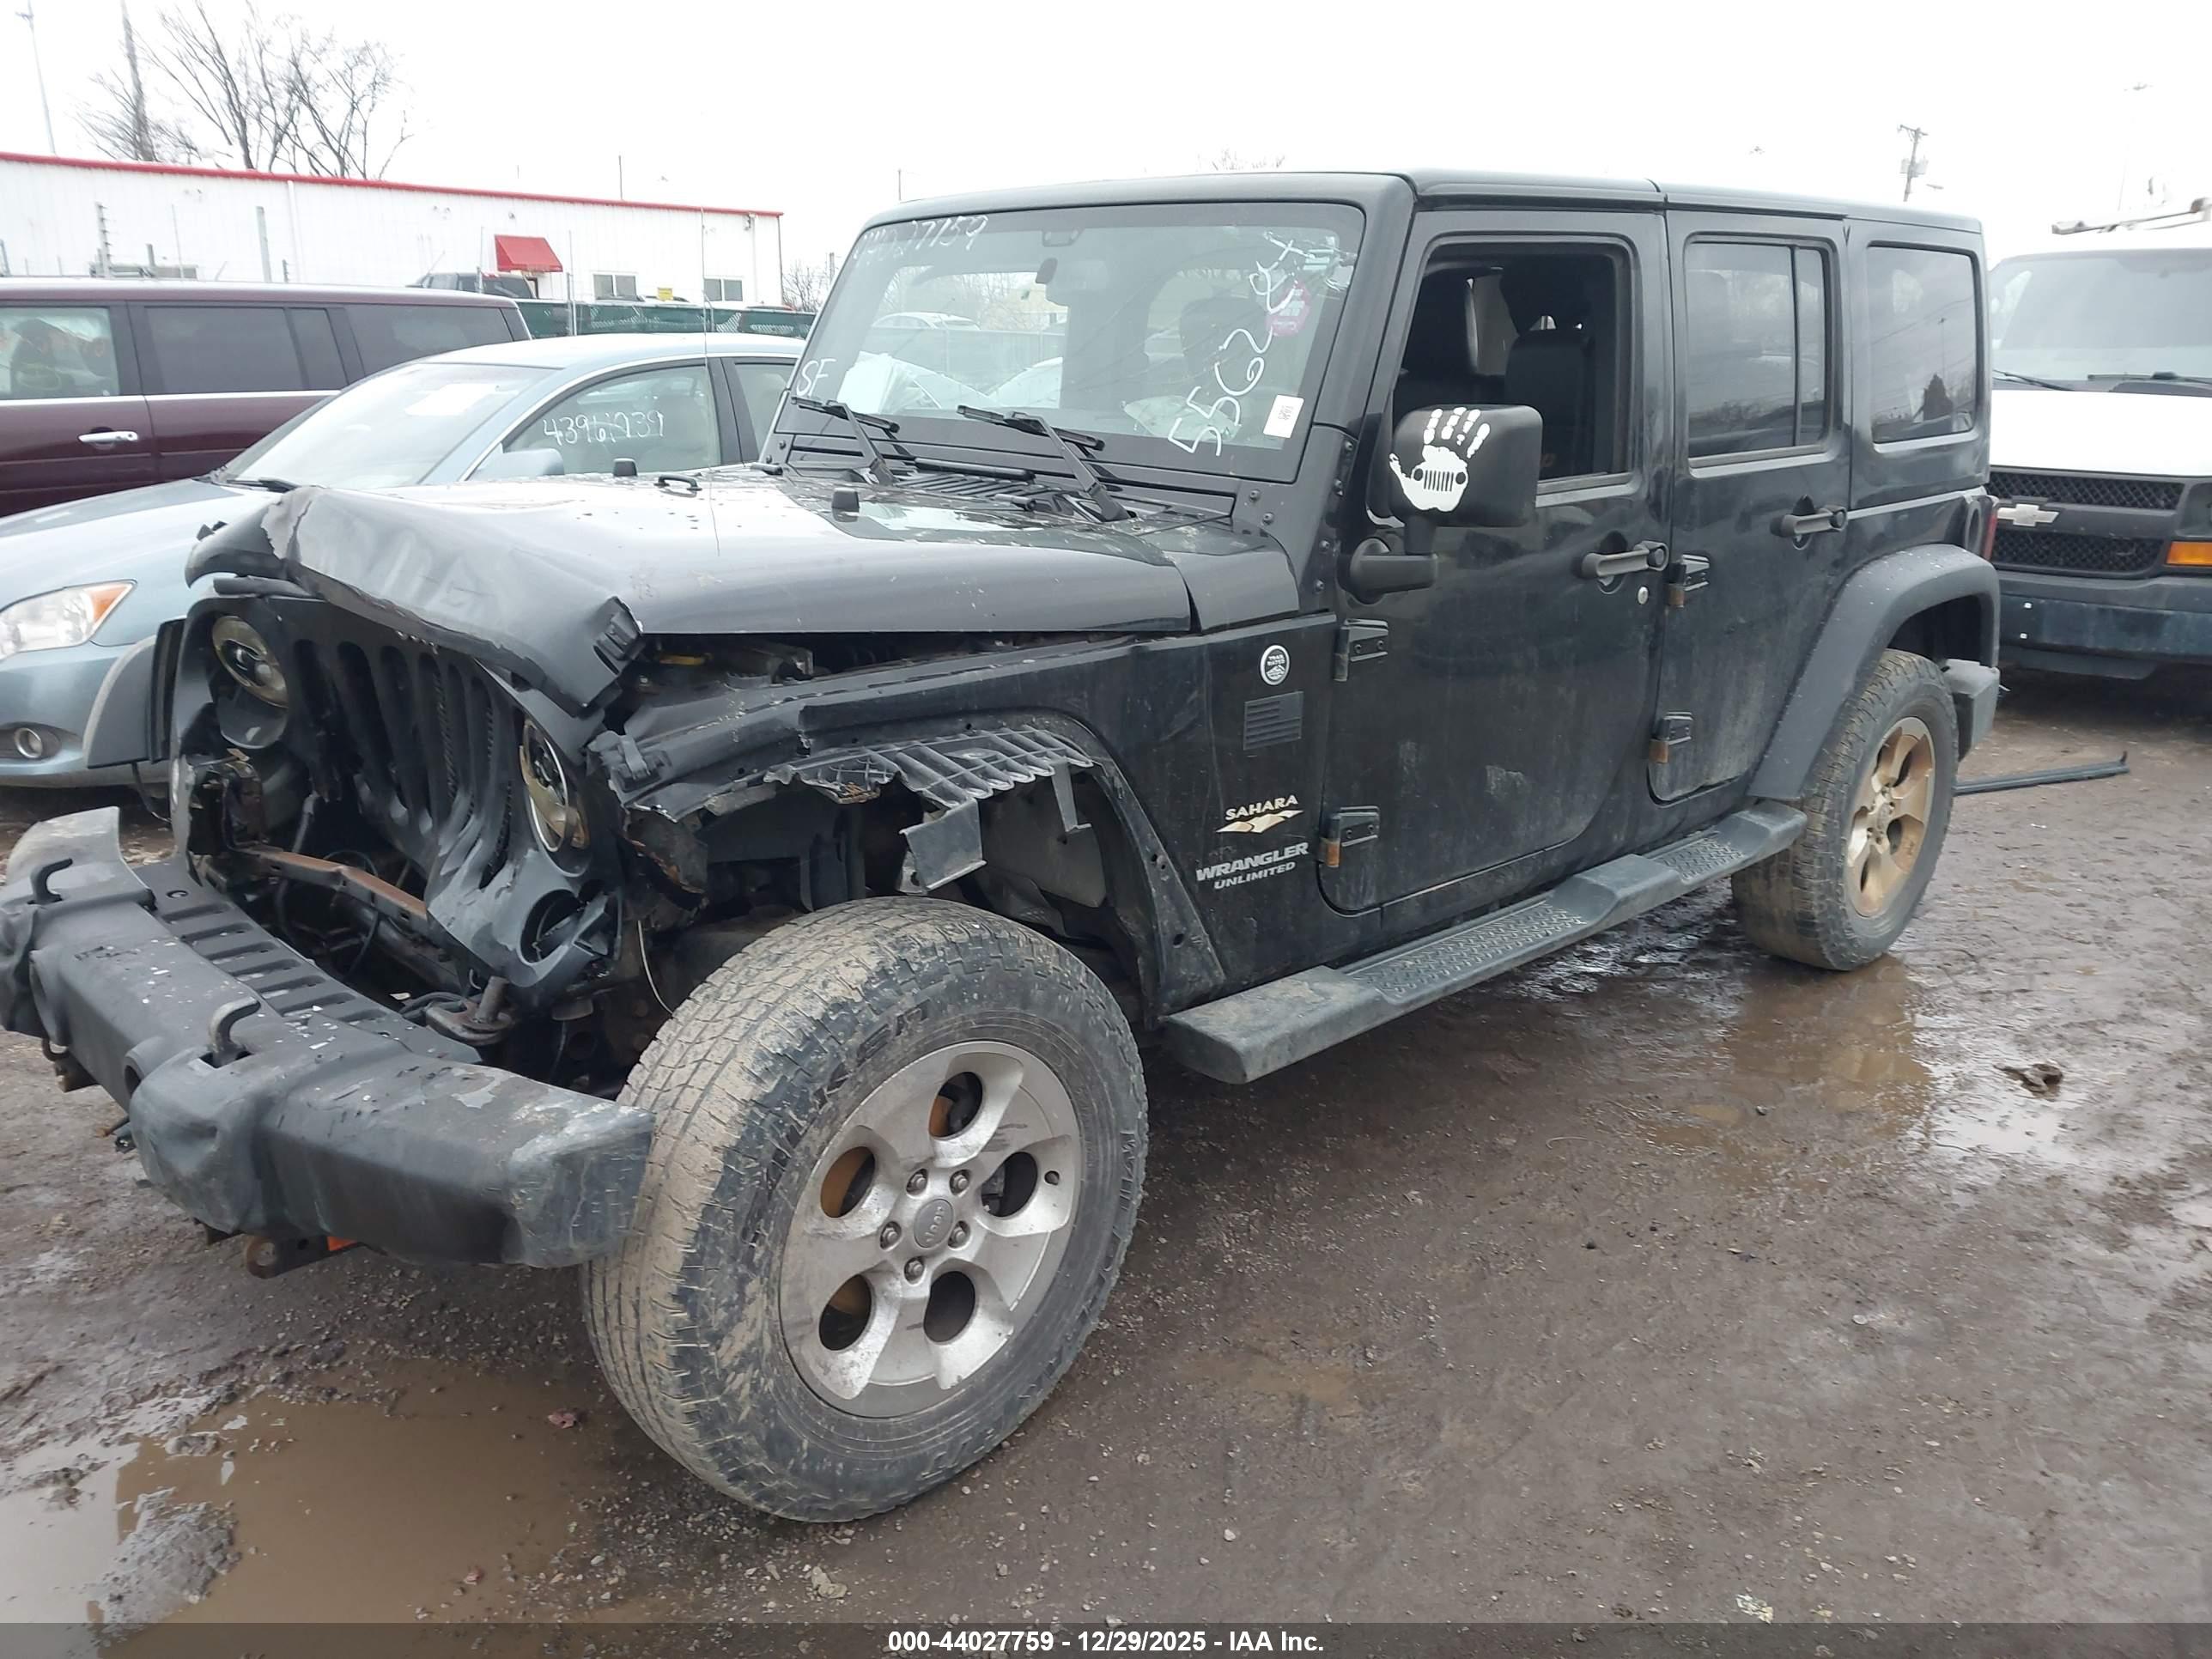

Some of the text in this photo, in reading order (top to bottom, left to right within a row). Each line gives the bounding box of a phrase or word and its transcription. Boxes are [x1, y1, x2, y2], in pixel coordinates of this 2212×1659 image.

[796, 358, 836, 398] SF
[1224, 794, 1298, 821] SAHARA
[1195, 842, 1310, 881] WRANGLER
[1213, 861, 1296, 890] UNLIMITED
